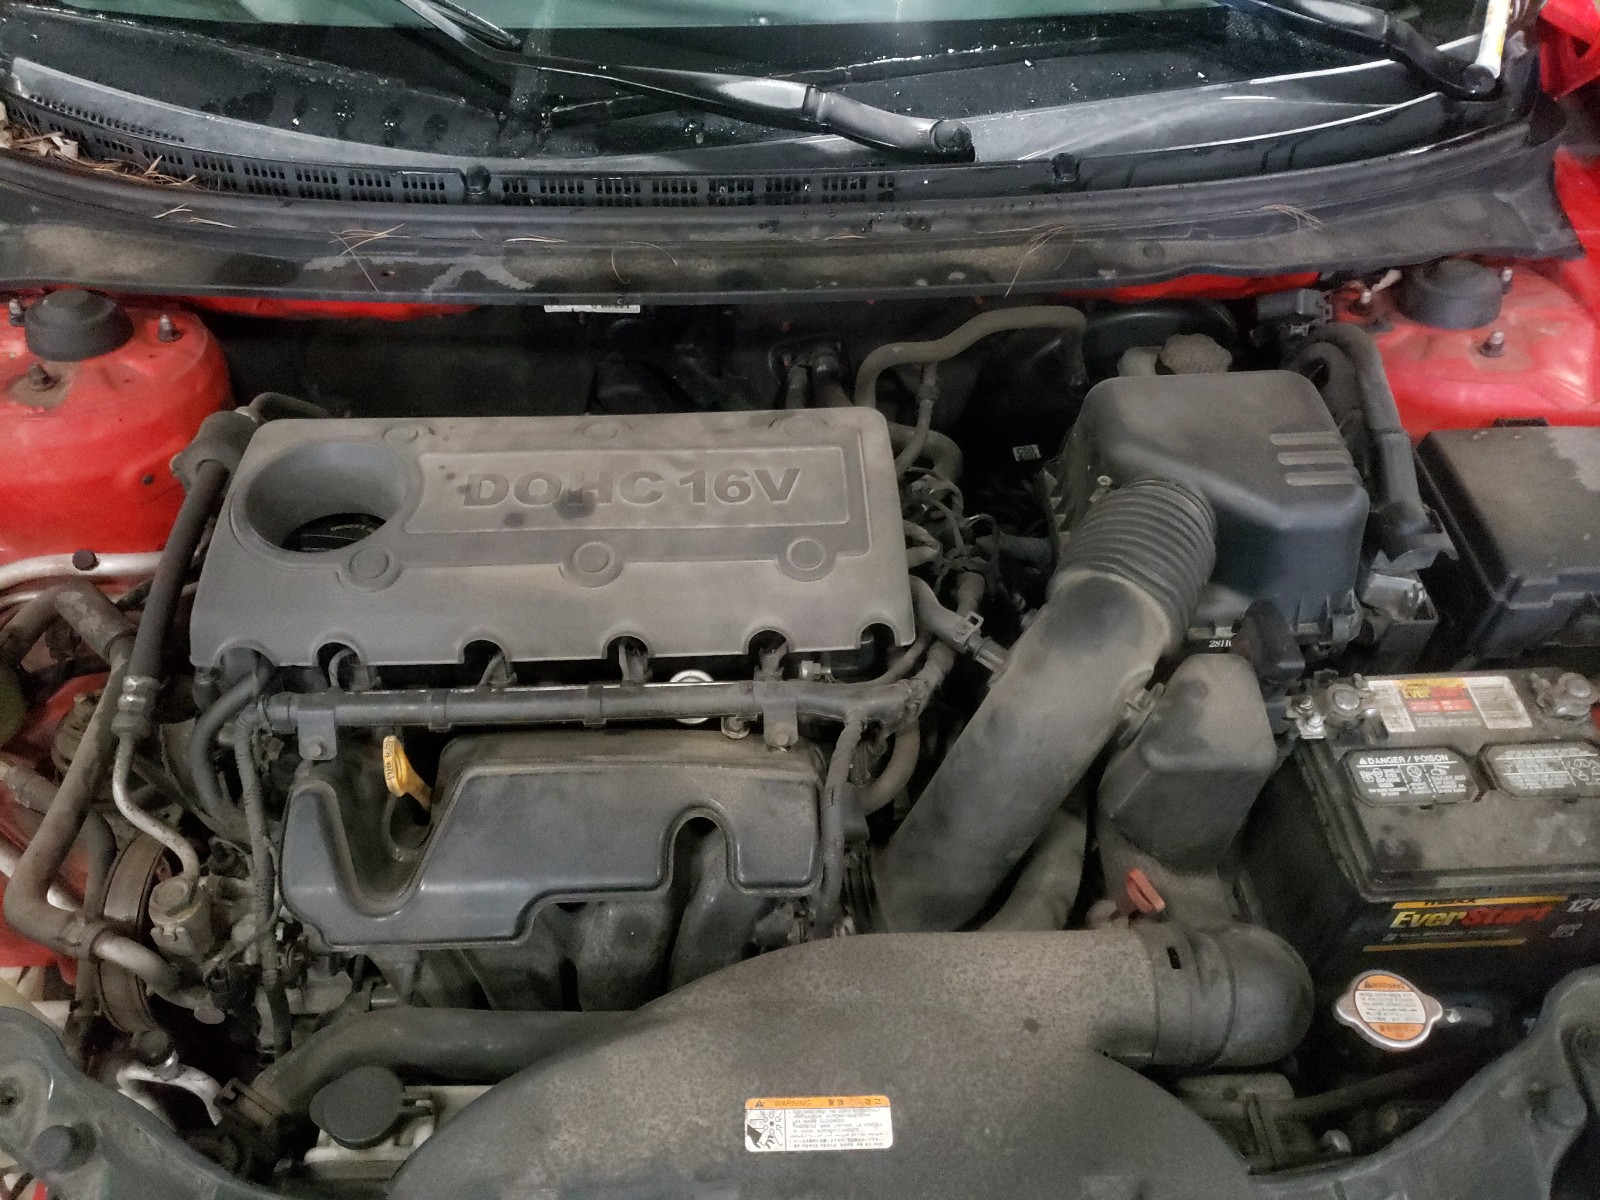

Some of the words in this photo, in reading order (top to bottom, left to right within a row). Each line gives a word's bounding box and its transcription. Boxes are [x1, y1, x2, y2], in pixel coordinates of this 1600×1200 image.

[463, 471, 664, 507] DOHC
[679, 468, 801, 505] 16V
[1367, 755, 1406, 765] DANGER
[1413, 754, 1449, 763] POISON
